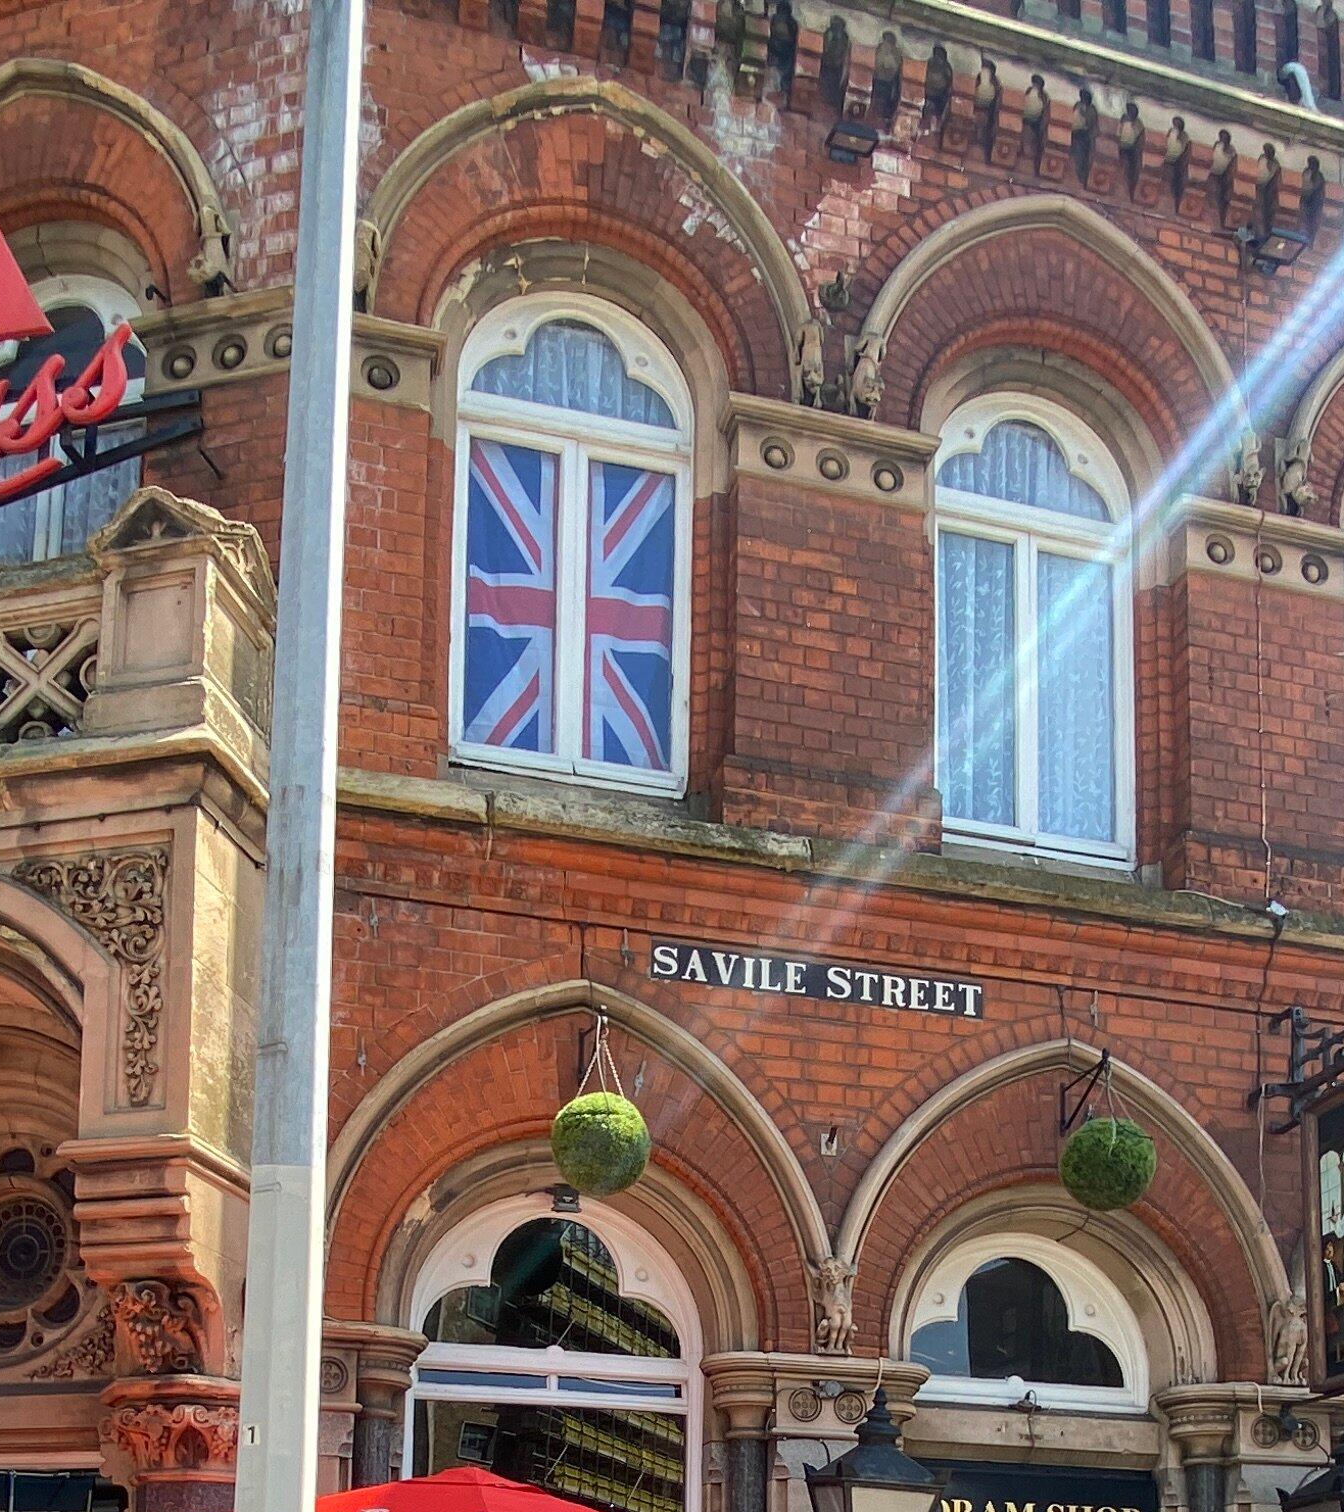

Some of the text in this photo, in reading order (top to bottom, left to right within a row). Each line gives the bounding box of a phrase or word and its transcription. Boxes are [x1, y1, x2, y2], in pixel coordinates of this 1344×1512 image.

[652, 945, 983, 1016] SAVILE STREET
[247, 1426, 255, 1444] 1
